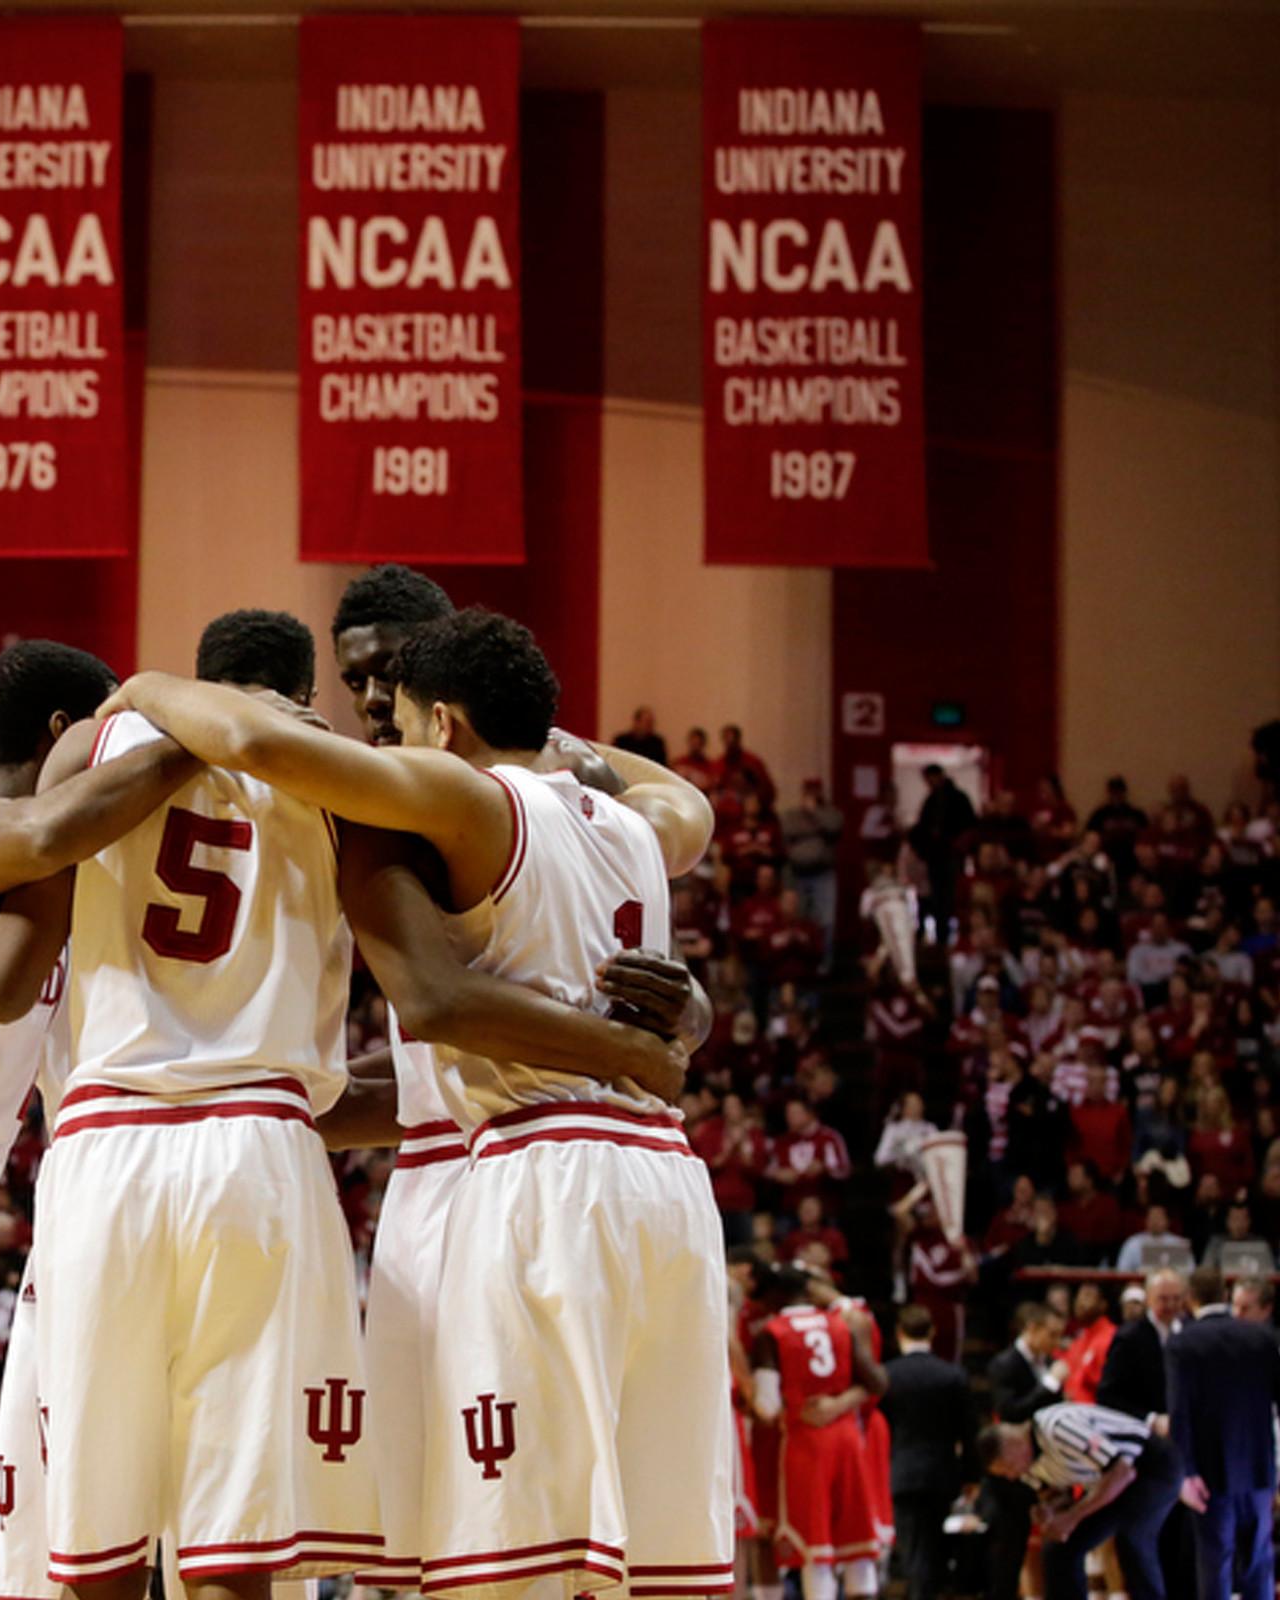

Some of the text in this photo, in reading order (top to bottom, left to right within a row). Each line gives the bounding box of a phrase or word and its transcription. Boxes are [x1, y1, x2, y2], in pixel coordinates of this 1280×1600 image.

[338, 85, 484, 131] INDIANA
[740, 88, 883, 134] INDIANA
[313, 143, 505, 191] UNIVERSITY
[715, 147, 904, 194] UNIVERSITY
[308, 217, 510, 289] NCAA
[710, 220, 910, 292] NCAA
[313, 313, 504, 362] BASKETBALL
[715, 317, 905, 366] BASKETBALL
[320, 373, 498, 421] CHAMPIONS
[724, 376, 900, 425] CHAMPIONS
[373, 447, 448, 495] 1981
[771, 451, 855, 499] 1987
[142, 807, 252, 963] 5
[804, 1331, 836, 1377] 3
